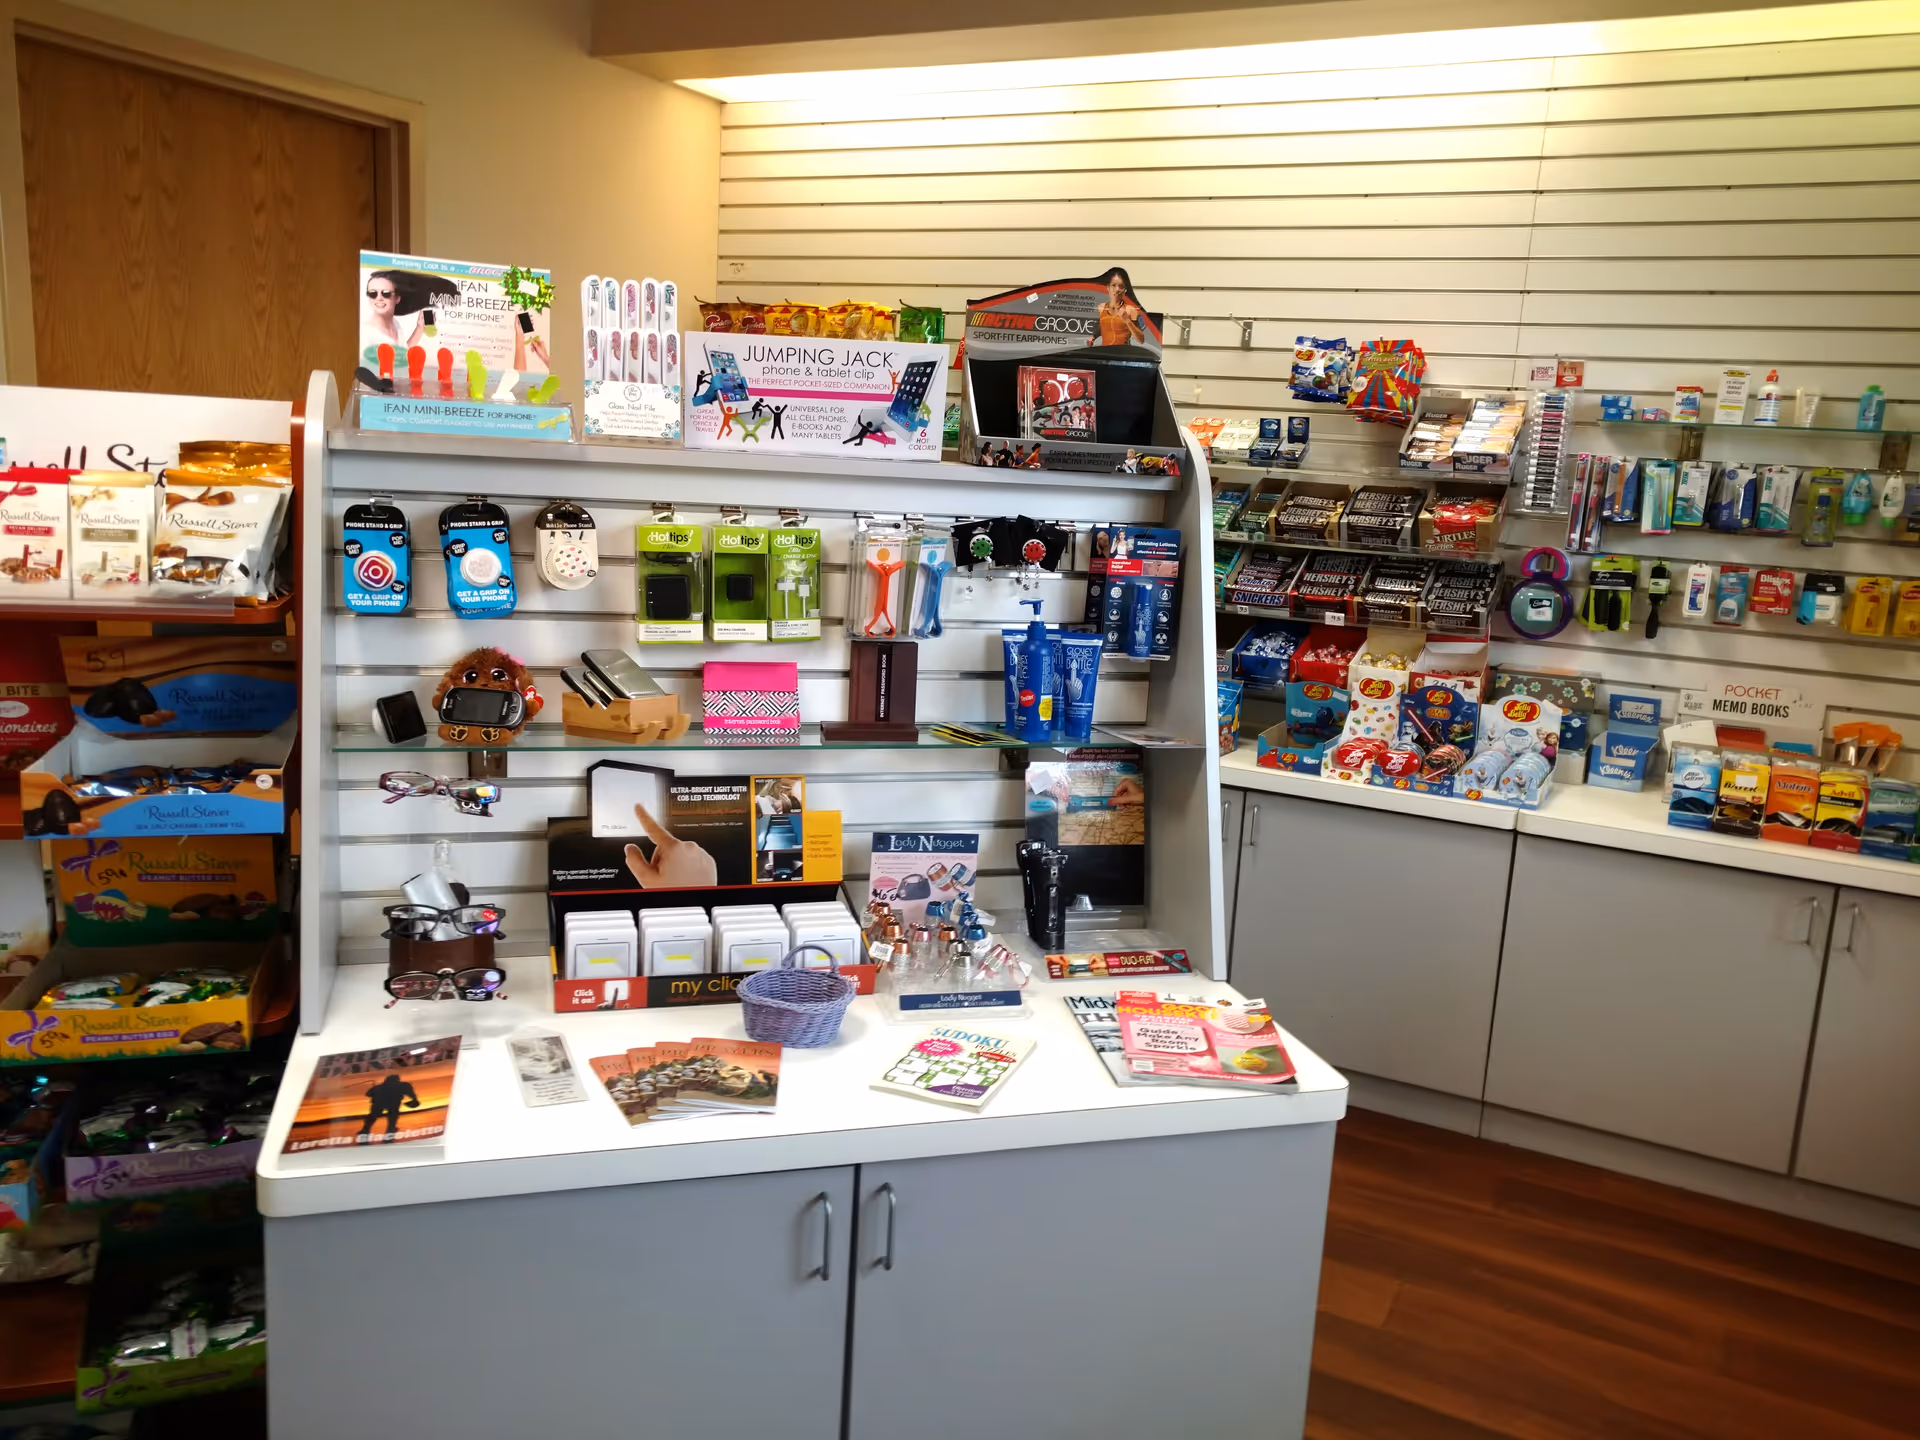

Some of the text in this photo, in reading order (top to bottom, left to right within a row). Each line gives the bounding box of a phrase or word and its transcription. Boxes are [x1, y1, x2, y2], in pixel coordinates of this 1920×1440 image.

[457, 279, 488, 293] iFAN
[428, 292, 515, 311] MINI-BREEZE
[445, 310, 463, 319] FOR
[1035, 316, 1094, 334] GROOVE
[973, 331, 1067, 344] SPORT-FIT EARPHONES
[743, 345, 893, 368] JUMPING JACK
[762, 366, 875, 381] phone & tablet clip
[762, 378, 792, 386] PERFECT
[794, 379, 843, 389] POCKET-SIZED
[844, 382, 890, 390] COMPANION
[384, 403, 411, 413] iFAN
[414, 405, 485, 418] MINI-BREEZE
[608, 402, 656, 412] Glass Nail File
[790, 405, 845, 414] UNIVERSAL FOR
[818, 415, 849, 424] PHONES,
[919, 428, 927, 437] 6
[1400, 460, 1423, 468] RUGER
[1455, 462, 1478, 471] RUGER
[1293, 496, 1336, 507] HERSHEY'S
[1354, 501, 1401, 511] HERSHEY'S
[0, 509, 30, 524] Russell
[80, 513, 110, 526] Russell
[169, 512, 259, 533] Russell Stover
[1348, 514, 1396, 526] HERSHEY'S
[1304, 573, 1356, 585] HERSHEY'S
[1375, 577, 1417, 589] HERSHEY'S
[1760, 574, 1791, 585] Blistex
[1300, 585, 1350, 597] HERSHEY'S
[1432, 588, 1485, 600] HERSHEY'S
[1234, 592, 1284, 606] SNICKERS
[1066, 646, 1093, 656] GLOVES
[6, 685, 40, 696] BITE
[1364, 679, 1386, 698] Jelly Belly
[1724, 683, 1782, 700] POCKET
[1020, 694, 1034, 702] Tester
[1515, 700, 1532, 713] Jelly
[1712, 699, 1747, 714] MEMO
[1750, 702, 1790, 718] BOOKS
[1508, 708, 1528, 720] Belly
[670, 786, 713, 794] ULTRA-BRIGHT
[731, 785, 747, 793] WITH
[703, 793, 741, 801] TECHNOLOGY
[144, 805, 230, 821] Russell Stover
[888, 834, 964, 852] Lady Nugget
[124, 852, 190, 871] Russell
[671, 975, 746, 996] my clic
[574, 989, 595, 997] Click
[940, 993, 982, 1002] Lady Nugget
[580, 996, 595, 1004] on!
[67, 1014, 133, 1034] Russell
[85, 1034, 123, 1043] PEANUT
[124, 1032, 155, 1042] BUTTER
[930, 1027, 1010, 1049] SUDOKU
[1136, 1032, 1200, 1042] Make Any
[1151, 1038, 1188, 1046] Room
[974, 1044, 1017, 1058] PUZZLES
[1144, 1042, 1197, 1051] Sparkle
[289, 1124, 444, 1151] Loretta Giacoletto
